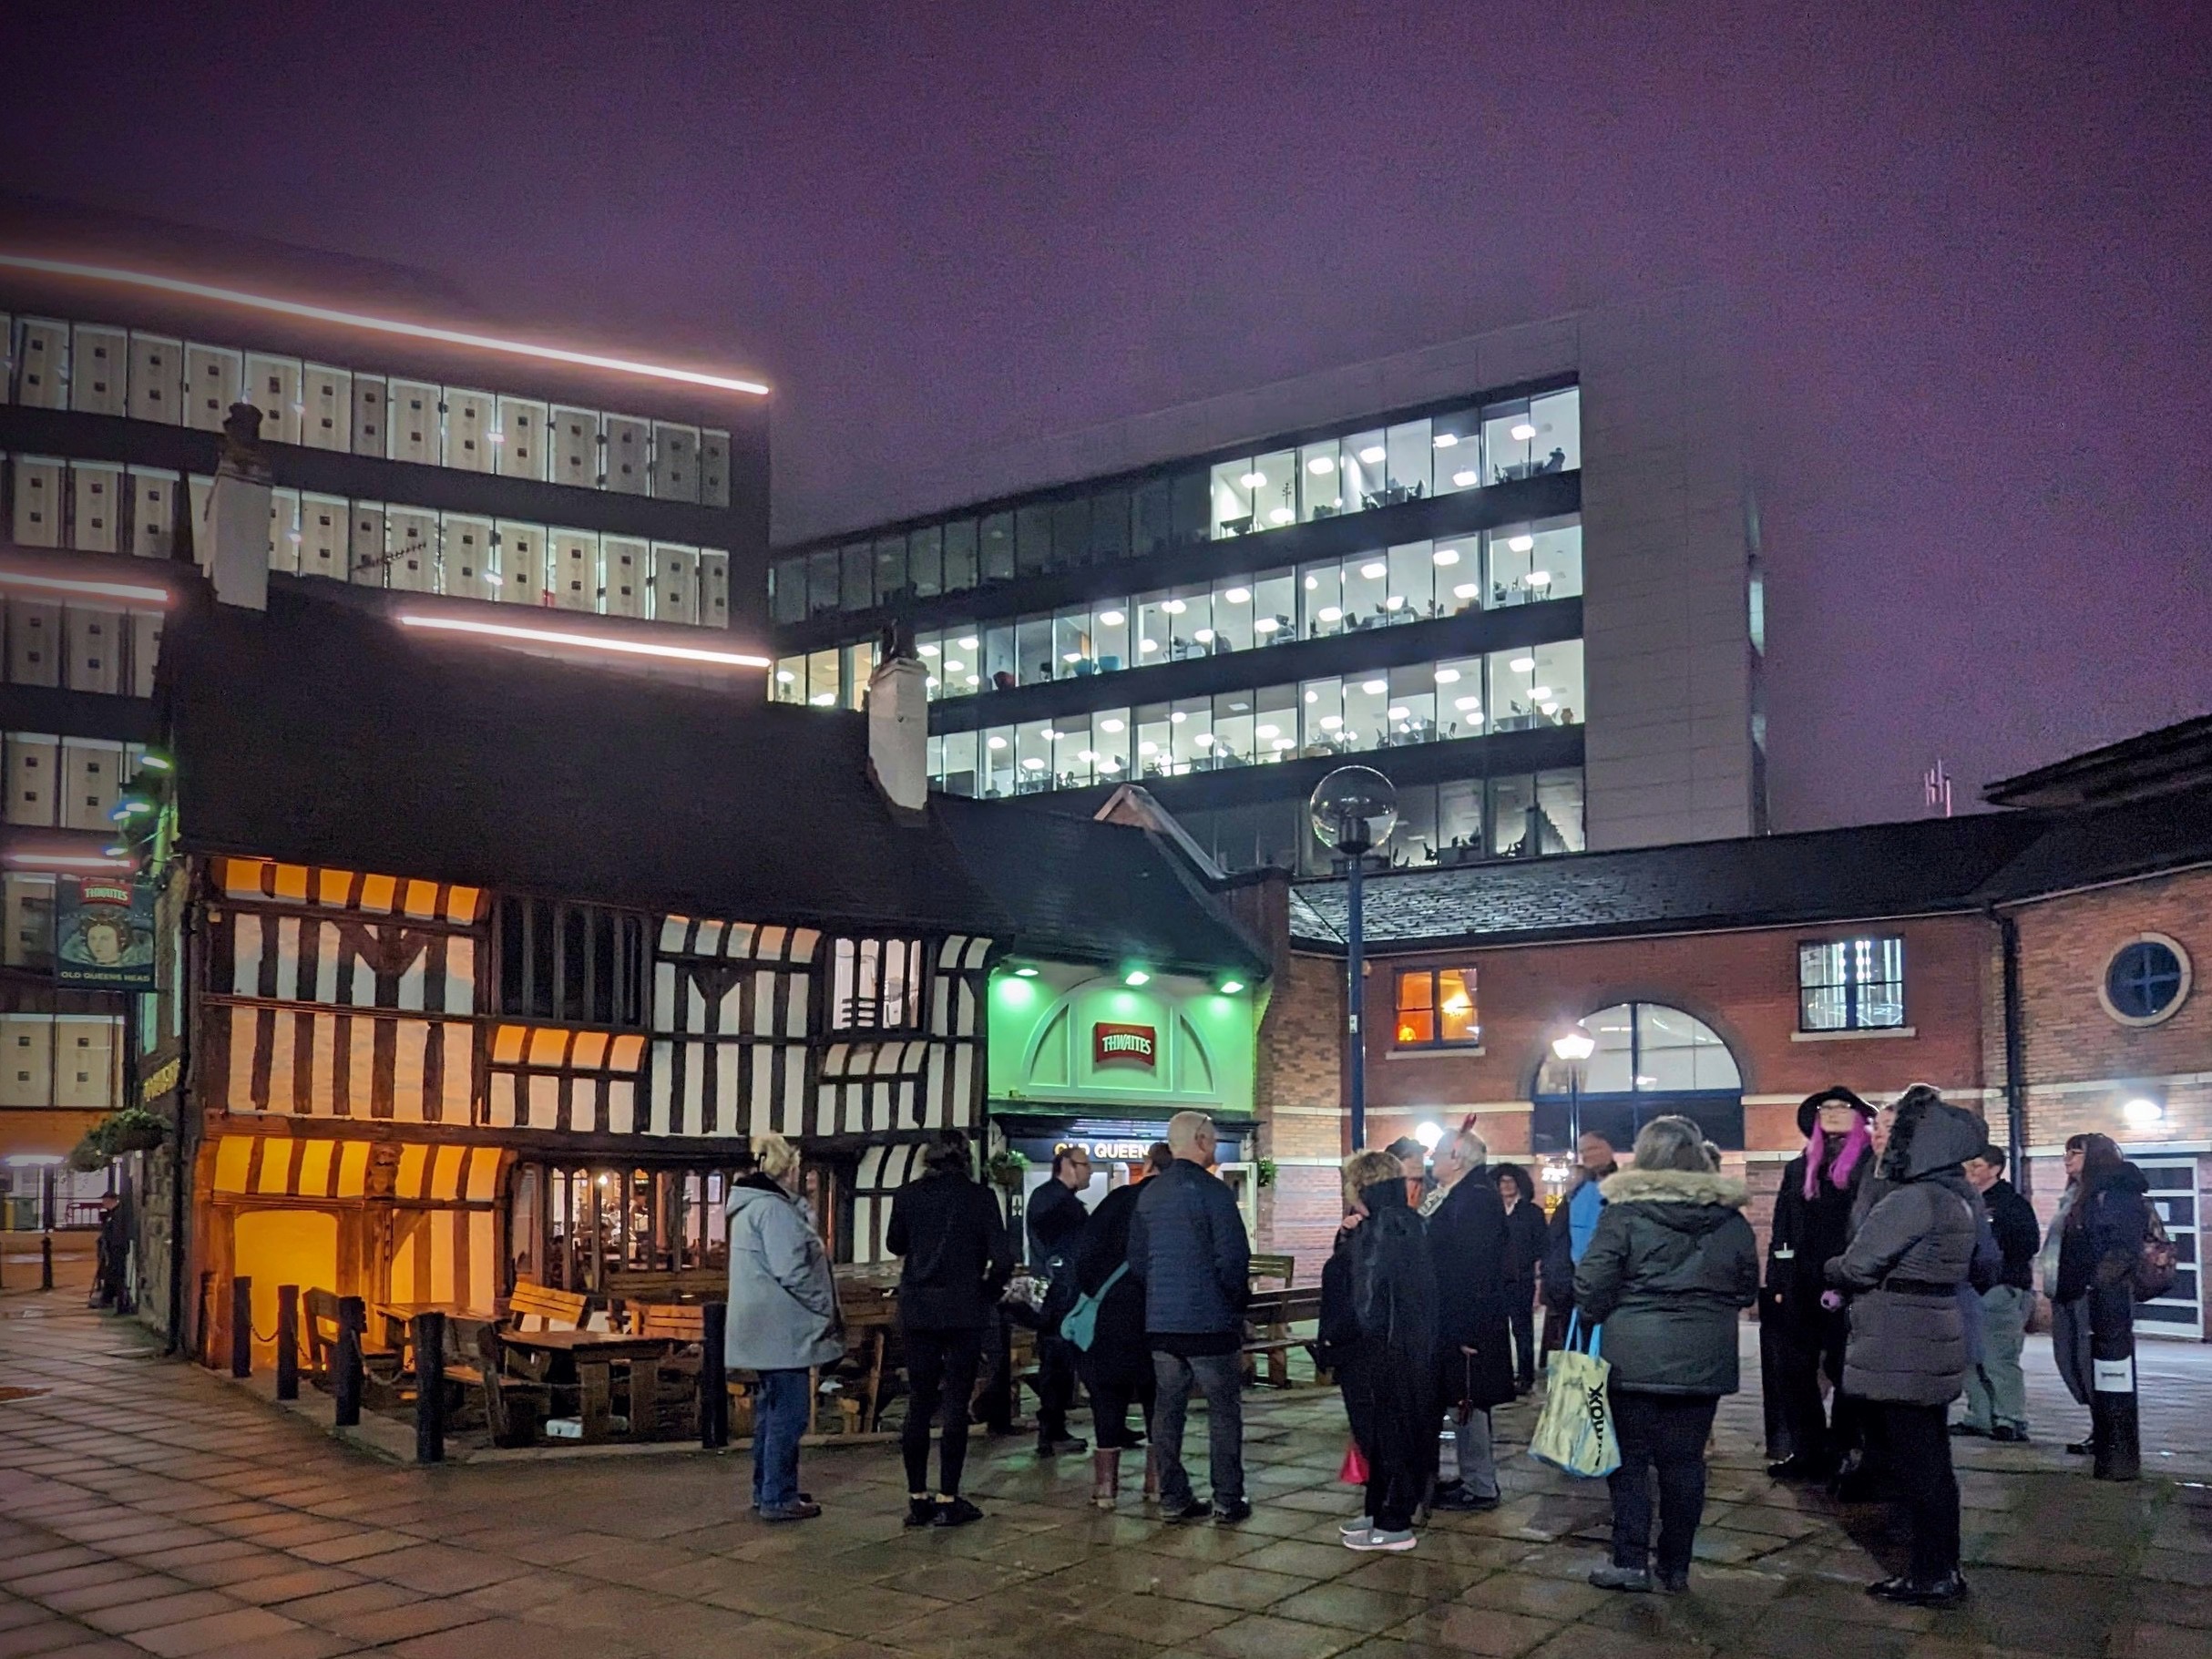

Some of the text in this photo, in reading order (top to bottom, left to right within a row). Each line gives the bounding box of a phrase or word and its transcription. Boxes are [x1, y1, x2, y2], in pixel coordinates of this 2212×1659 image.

[61, 971, 82, 979] OLD
[123, 974, 150, 982] HEAD
[1101, 1033, 1152, 1055] THWAITES
[1054, 1142, 1091, 1156] OD
